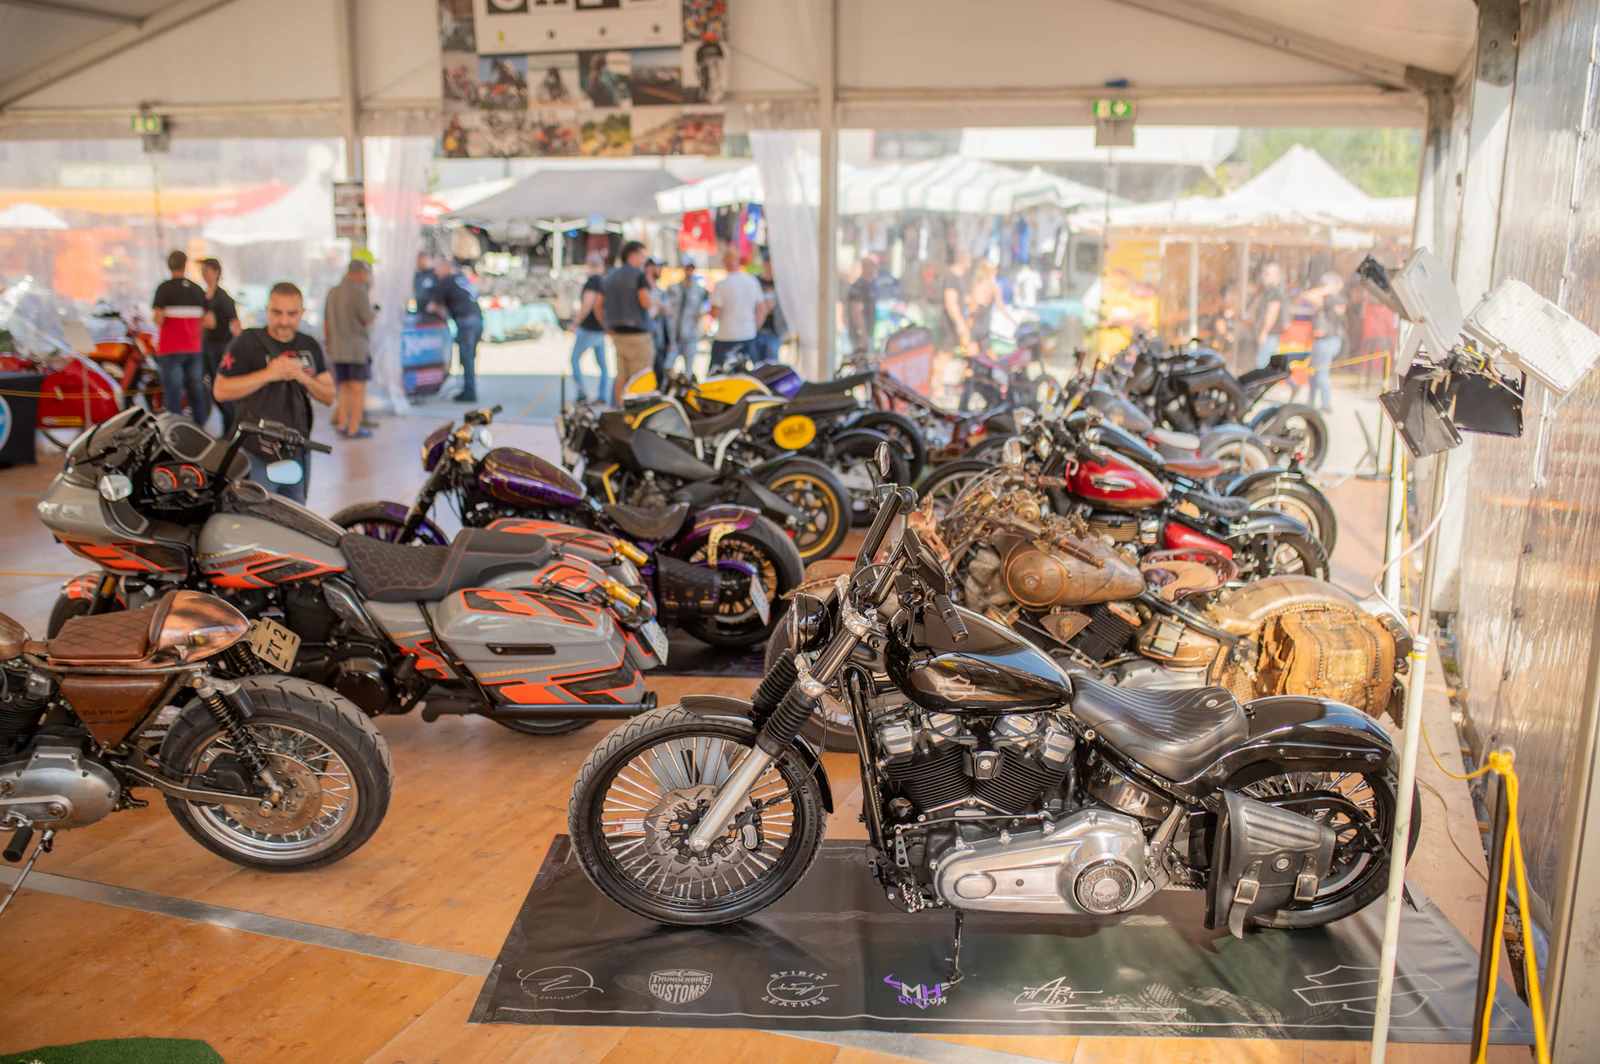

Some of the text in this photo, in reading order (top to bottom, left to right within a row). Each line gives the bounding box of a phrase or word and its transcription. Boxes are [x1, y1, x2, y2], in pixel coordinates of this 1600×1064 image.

[265, 628, 287, 661] ZT 2
[651, 974, 711, 985] THUNDERBIKE
[651, 983, 707, 1003] CUSTOMS
[901, 982, 942, 1001] MH
[761, 995, 829, 1008] LEATHER
[897, 995, 948, 1007] CUSTOM
